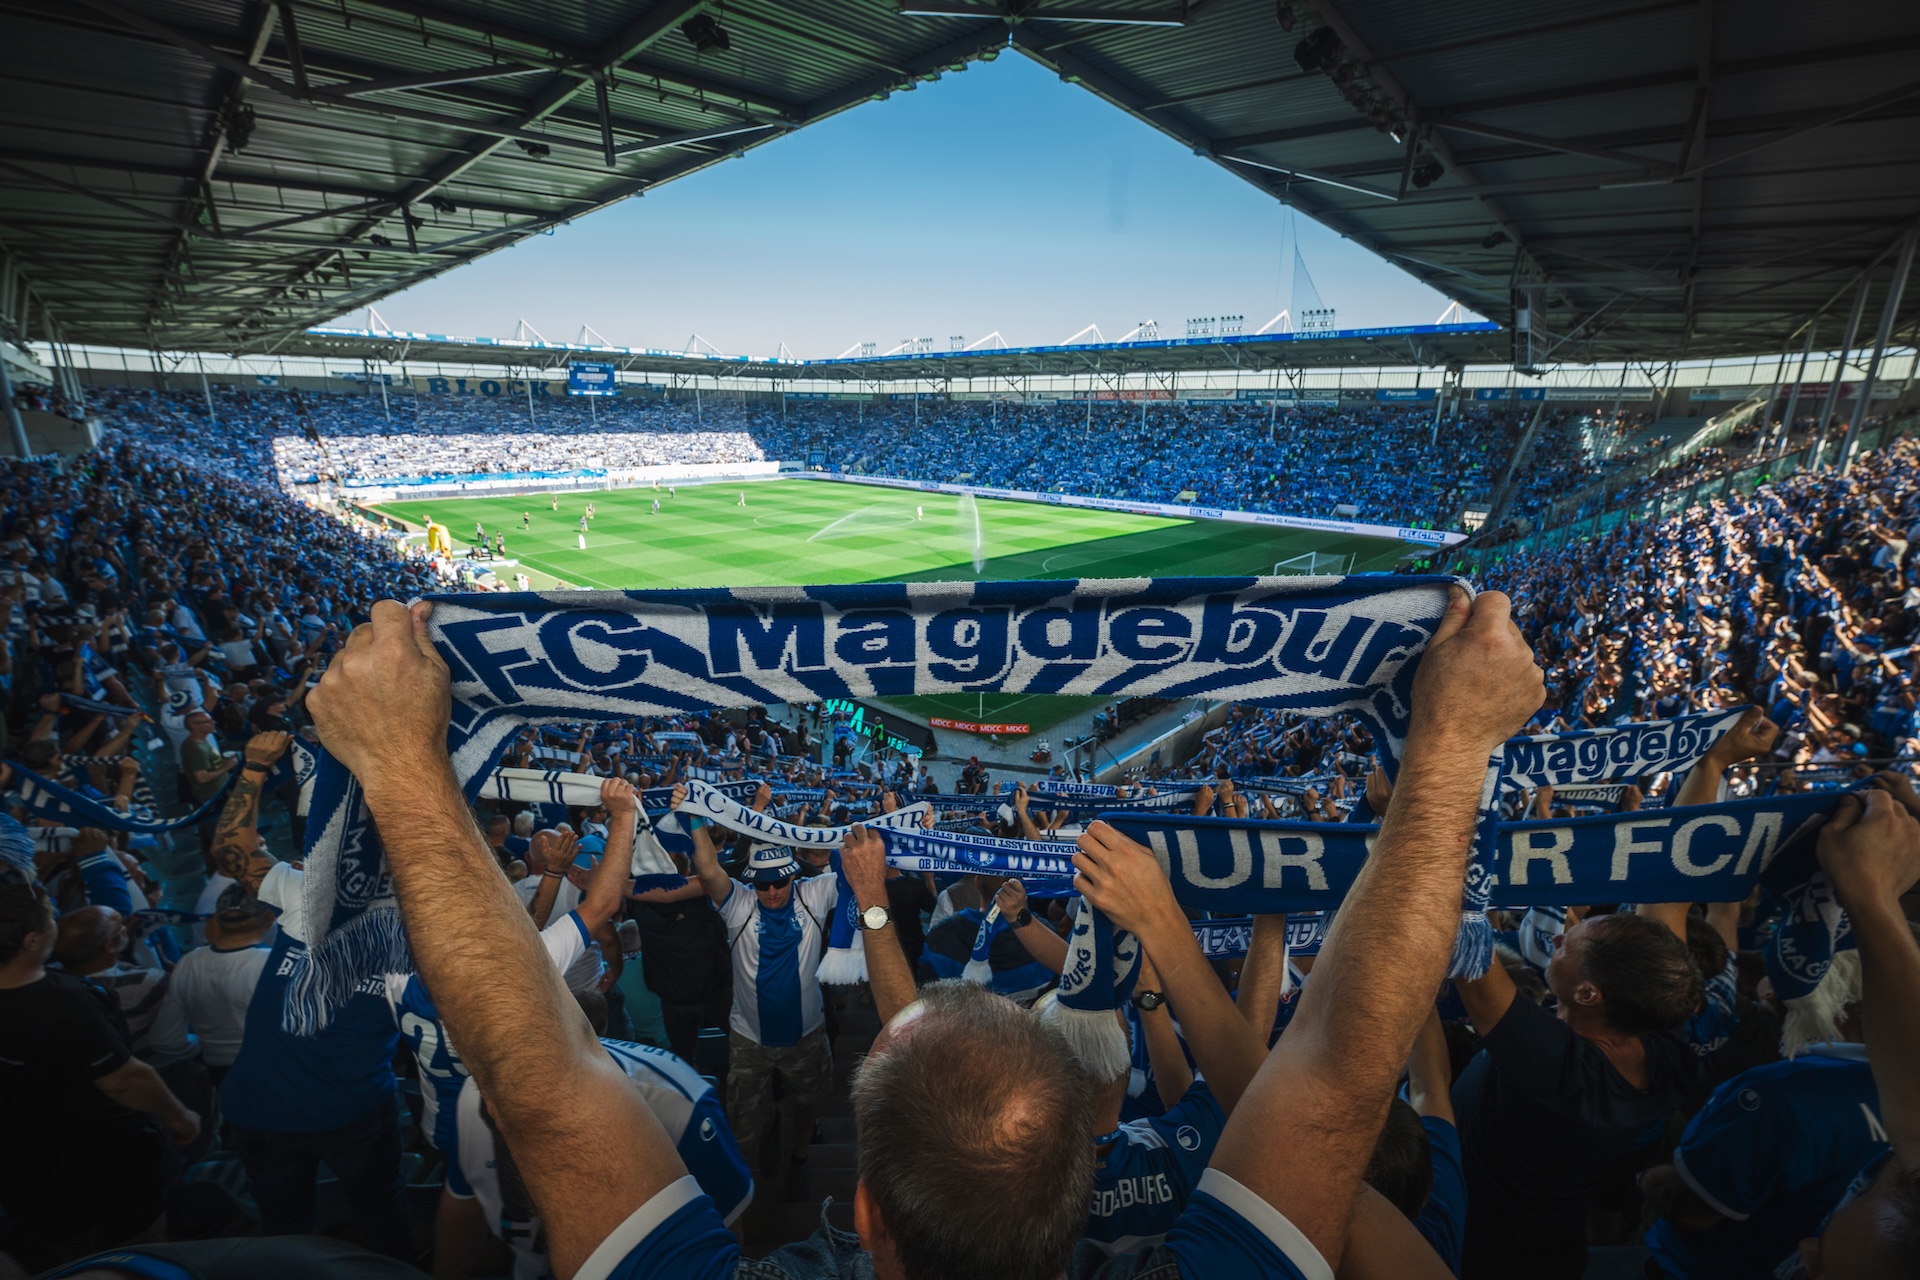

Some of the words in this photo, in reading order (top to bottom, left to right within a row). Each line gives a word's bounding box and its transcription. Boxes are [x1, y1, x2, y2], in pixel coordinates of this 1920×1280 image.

[427, 377, 551, 396] BLOCK
[1190, 509, 1222, 517] SELECTRIC
[1400, 529, 1444, 541] SELECTRIC
[438, 607, 653, 705] FC
[698, 592, 1434, 690] Magdebur
[931, 718, 952, 728] MDCC
[955, 721, 976, 731] MDCC
[684, 782, 727, 814] FC
[734, 808, 925, 845] MAGDUR
[955, 834, 970, 844] IM
[972, 836, 997, 847] DICH
[998, 838, 1029, 851] LASST
[918, 858, 932, 870] OB
[933, 858, 946, 871] DU
